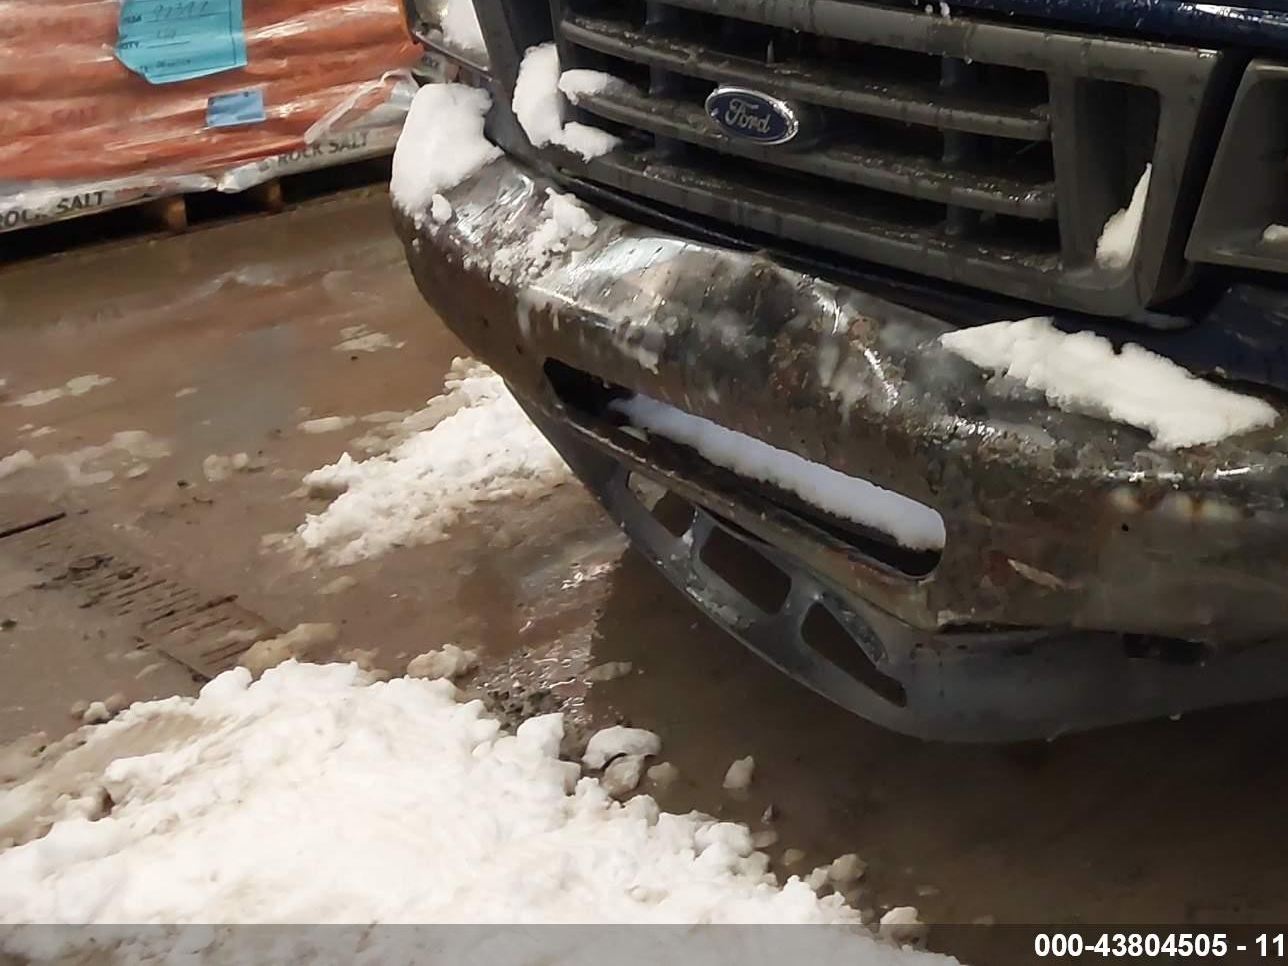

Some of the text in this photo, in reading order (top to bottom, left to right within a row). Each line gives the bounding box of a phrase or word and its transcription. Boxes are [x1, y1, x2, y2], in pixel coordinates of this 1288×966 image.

[724, 98, 770, 134] Ford
[278, 132, 368, 165] ROCK SALT
[0, 190, 106, 228] OC SALT
